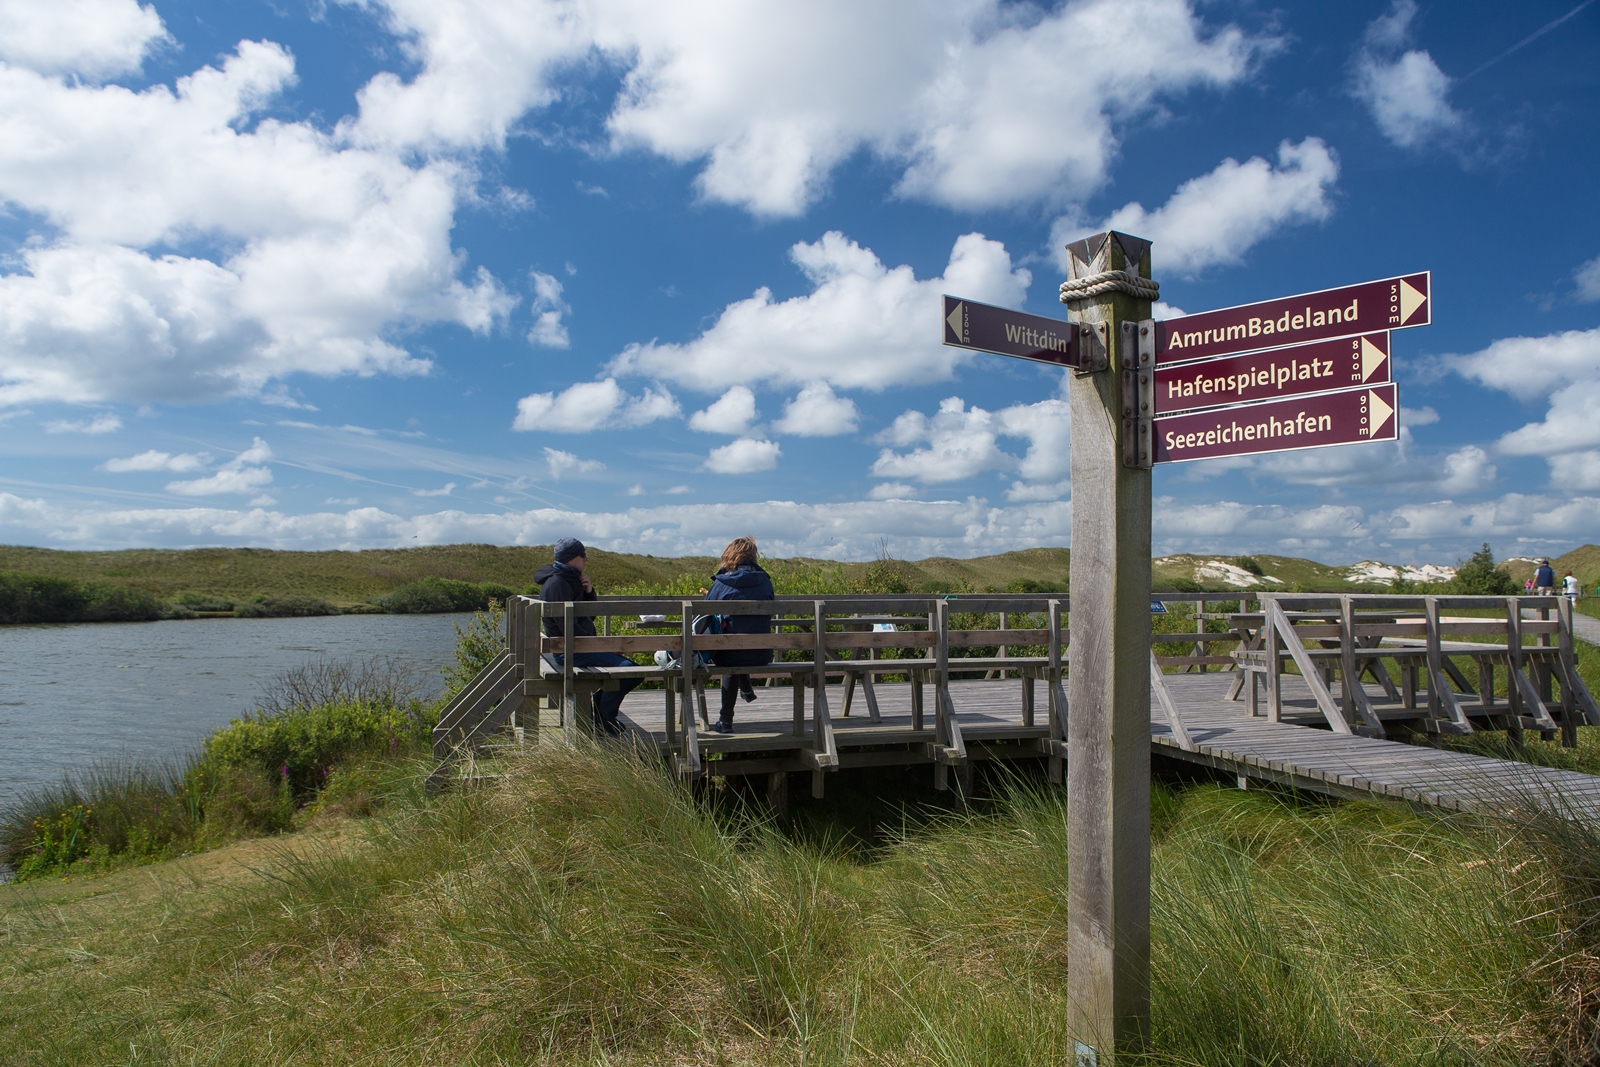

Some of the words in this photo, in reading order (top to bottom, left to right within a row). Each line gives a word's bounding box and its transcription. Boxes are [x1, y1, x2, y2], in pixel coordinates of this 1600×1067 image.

[1004, 323, 1067, 353] Wittdün
[1168, 298, 1358, 350] AmrumBadeland
[1168, 357, 1334, 398] Hafenspielplatz
[1165, 410, 1332, 451] Seezeichenhafen
